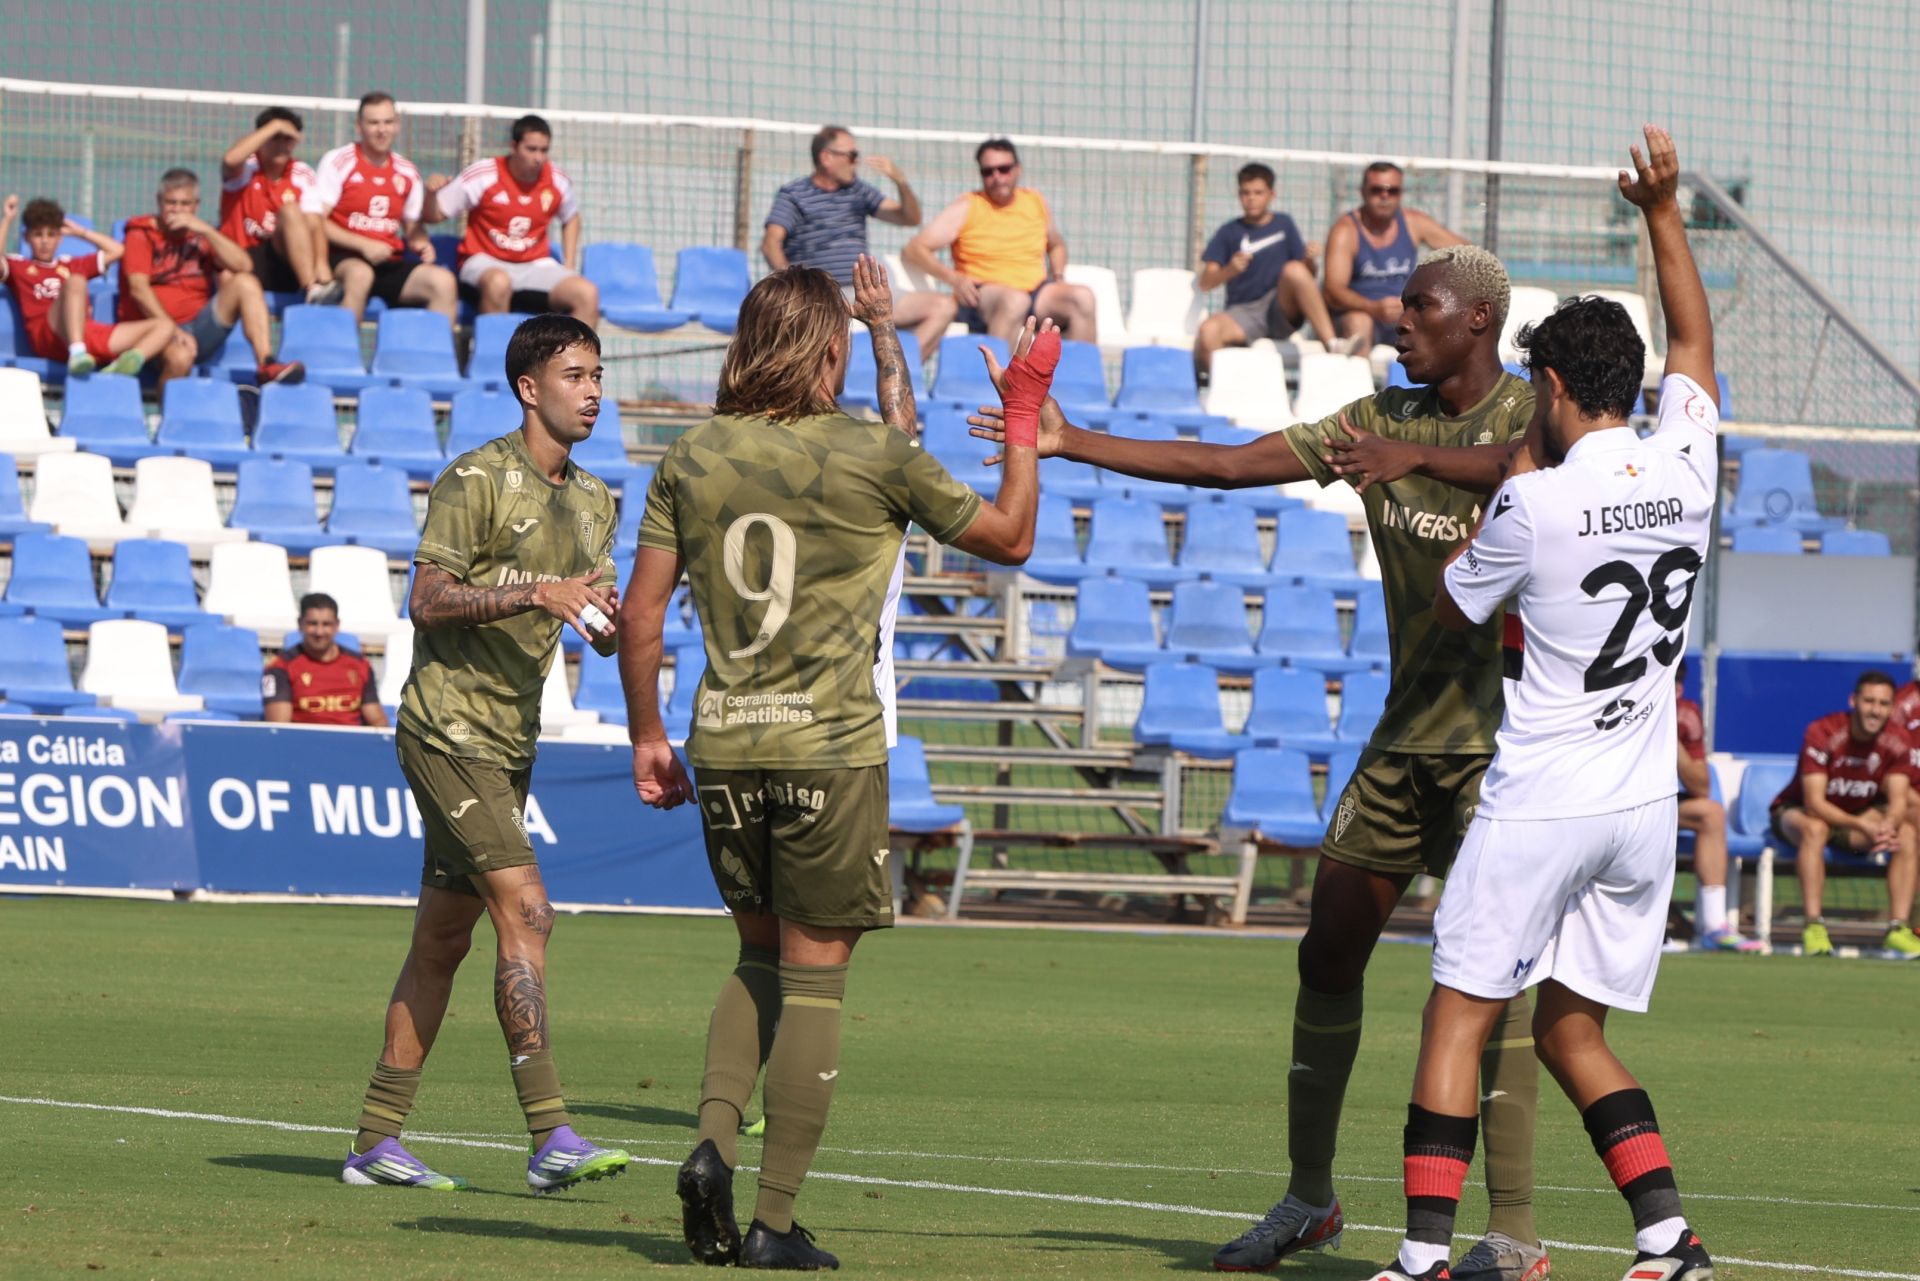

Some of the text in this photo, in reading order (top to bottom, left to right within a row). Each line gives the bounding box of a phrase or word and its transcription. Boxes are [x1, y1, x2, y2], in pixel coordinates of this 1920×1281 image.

[1579, 497, 1684, 537] J.ESCOBAR
[724, 513, 797, 659] 9
[1580, 546, 1704, 693] 29
[726, 691, 814, 707] cerramientos
[726, 706, 813, 725] abatibles
[27, 734, 126, 766] Cálida
[208, 777, 290, 832] OF
